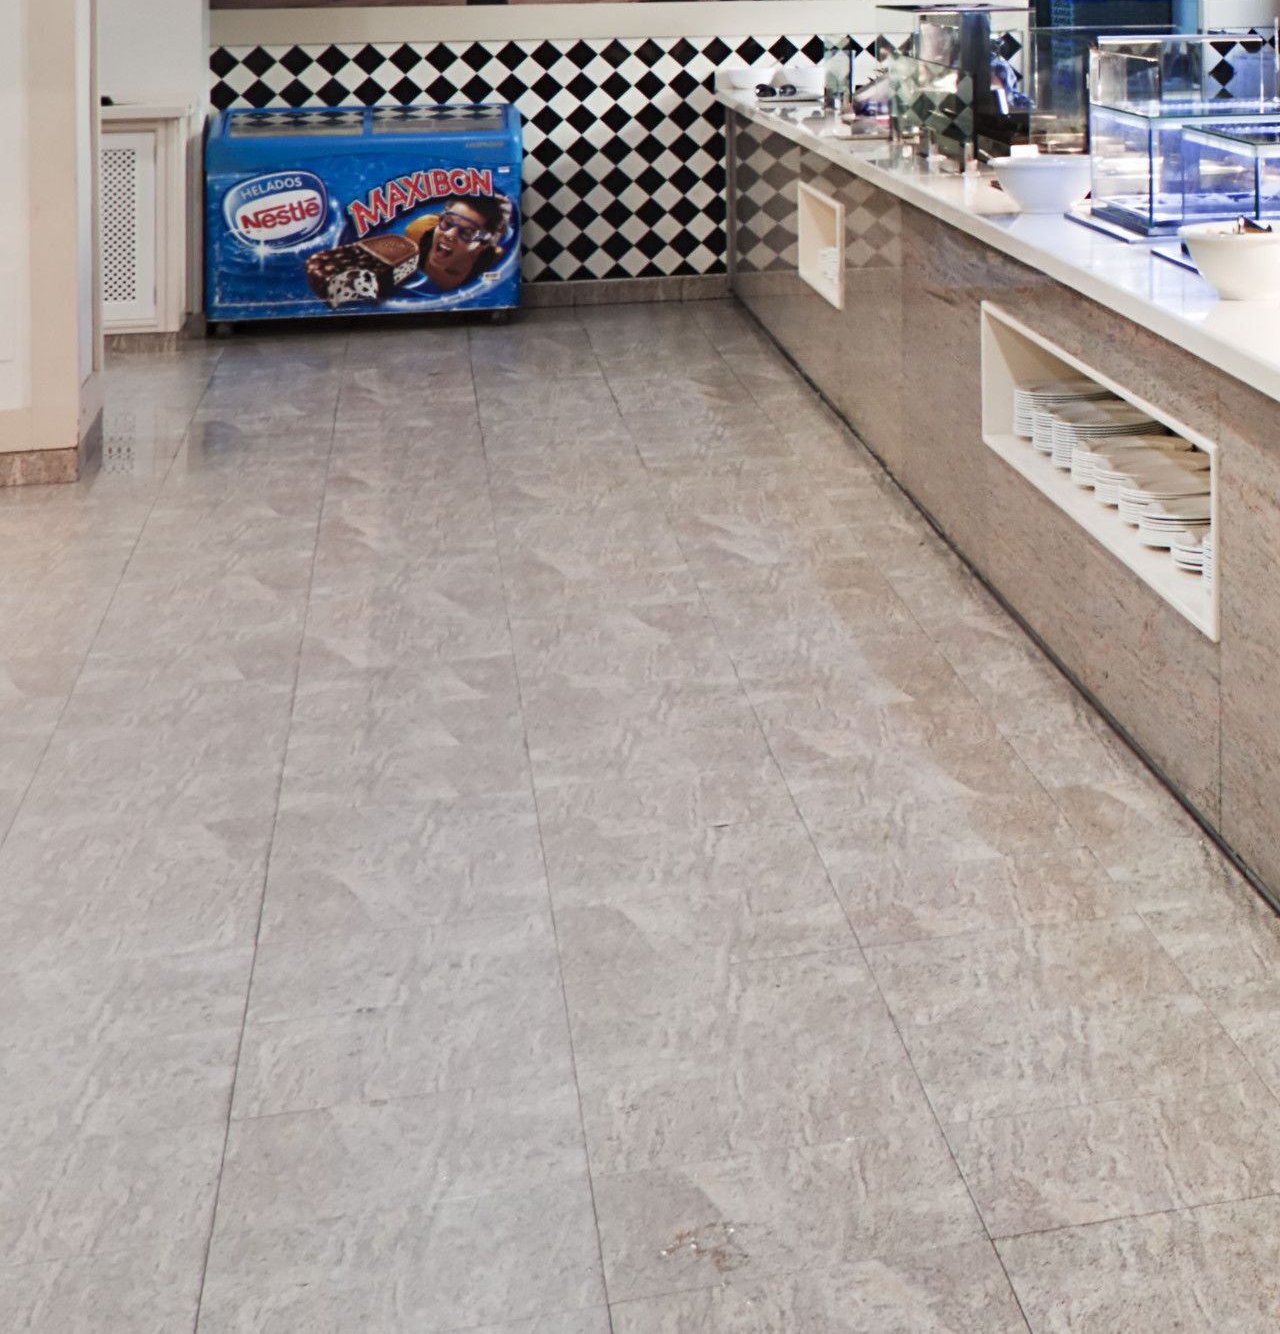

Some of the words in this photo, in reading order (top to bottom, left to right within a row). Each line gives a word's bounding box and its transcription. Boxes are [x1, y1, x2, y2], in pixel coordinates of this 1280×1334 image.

[240, 177, 303, 200] HELADOS
[348, 167, 493, 237] MAXIBON
[241, 197, 320, 234] Nestlé
